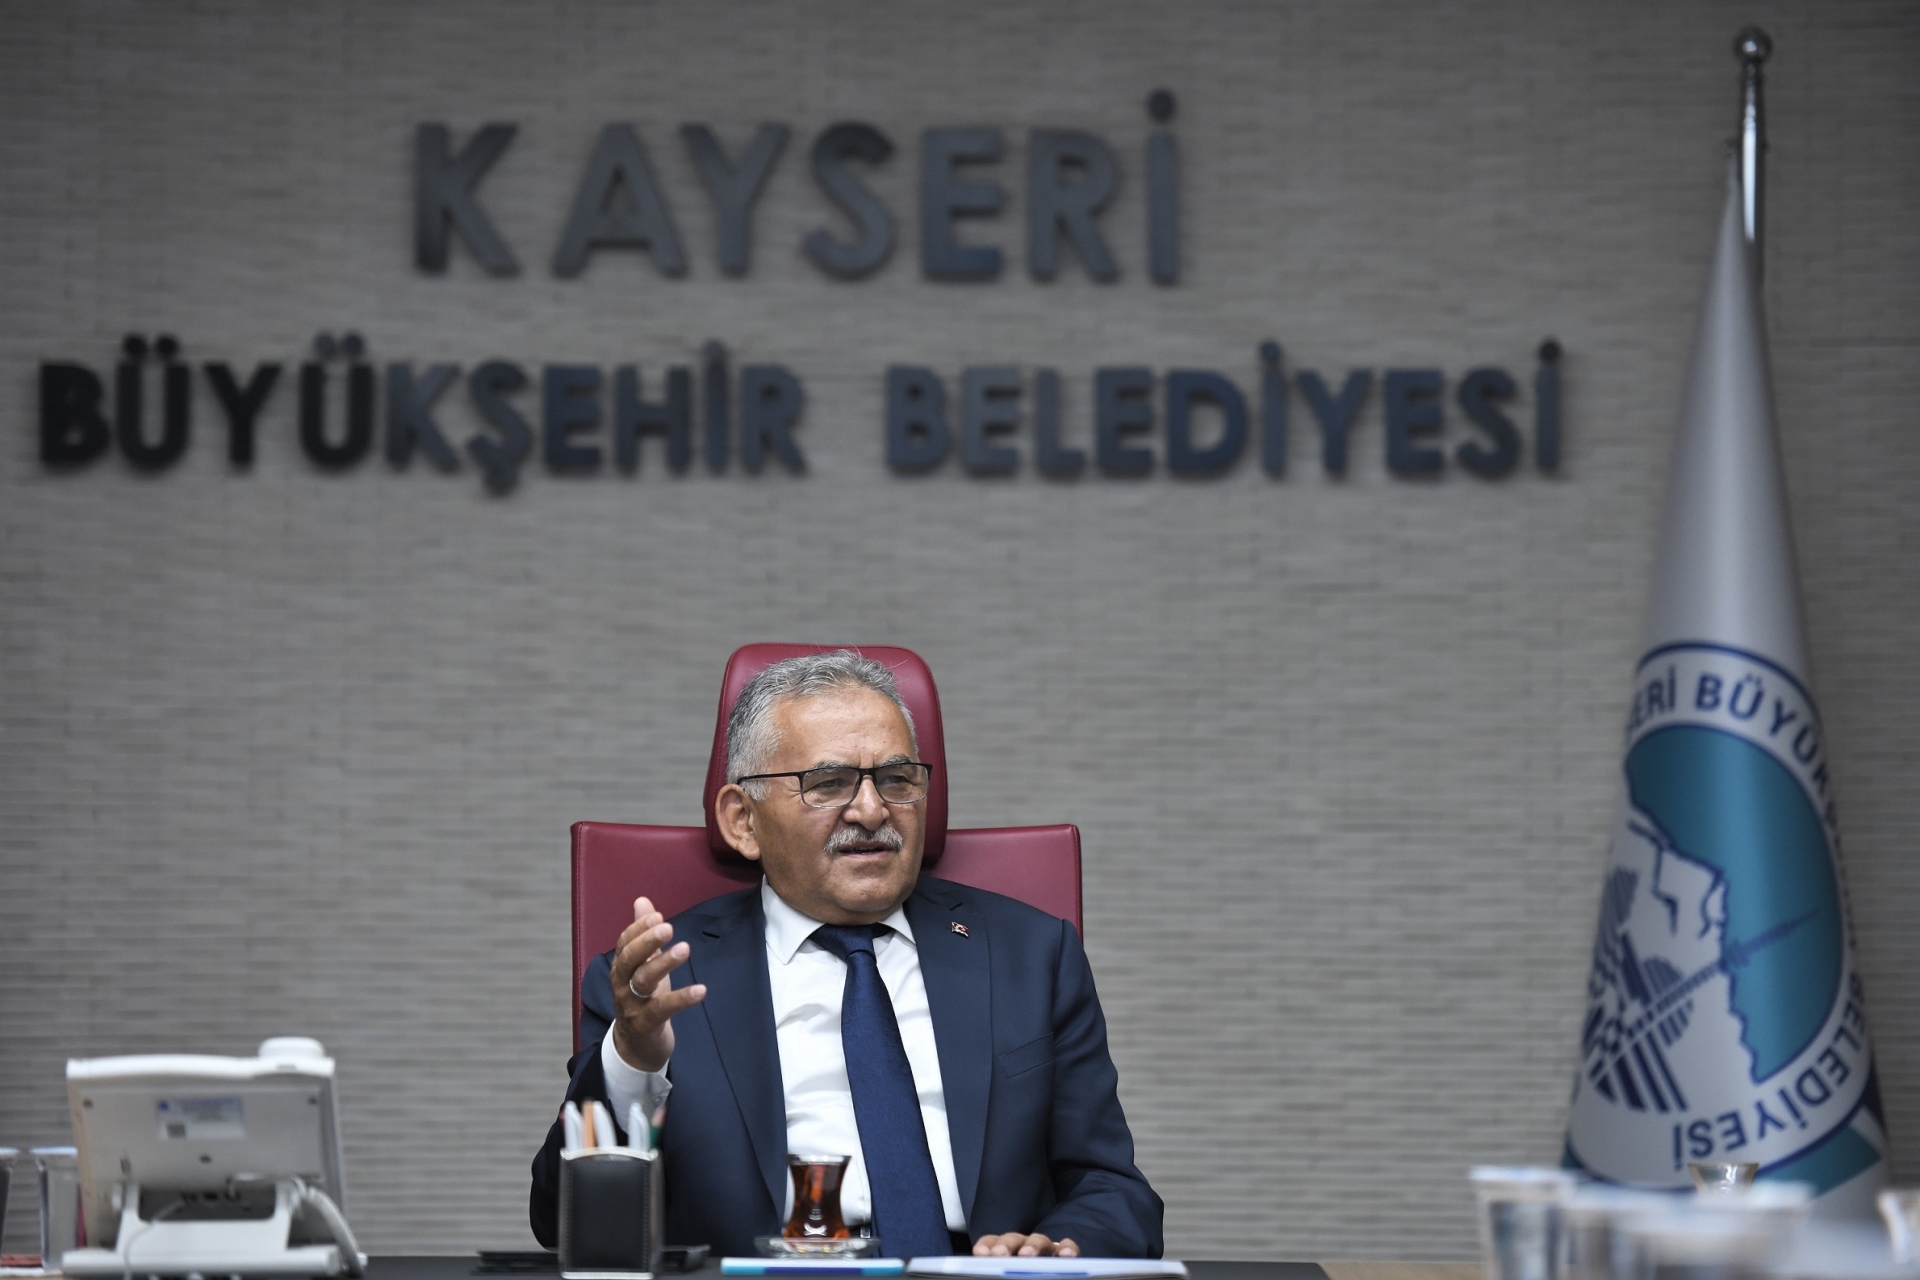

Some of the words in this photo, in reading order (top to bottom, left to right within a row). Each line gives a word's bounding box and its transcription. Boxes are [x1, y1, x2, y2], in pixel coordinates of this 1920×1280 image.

[412, 88, 1181, 287] KAYSERİ
[37, 332, 807, 497] BÜYÜKŞEHİR
[885, 338, 1566, 482] BELEDİYESİ
